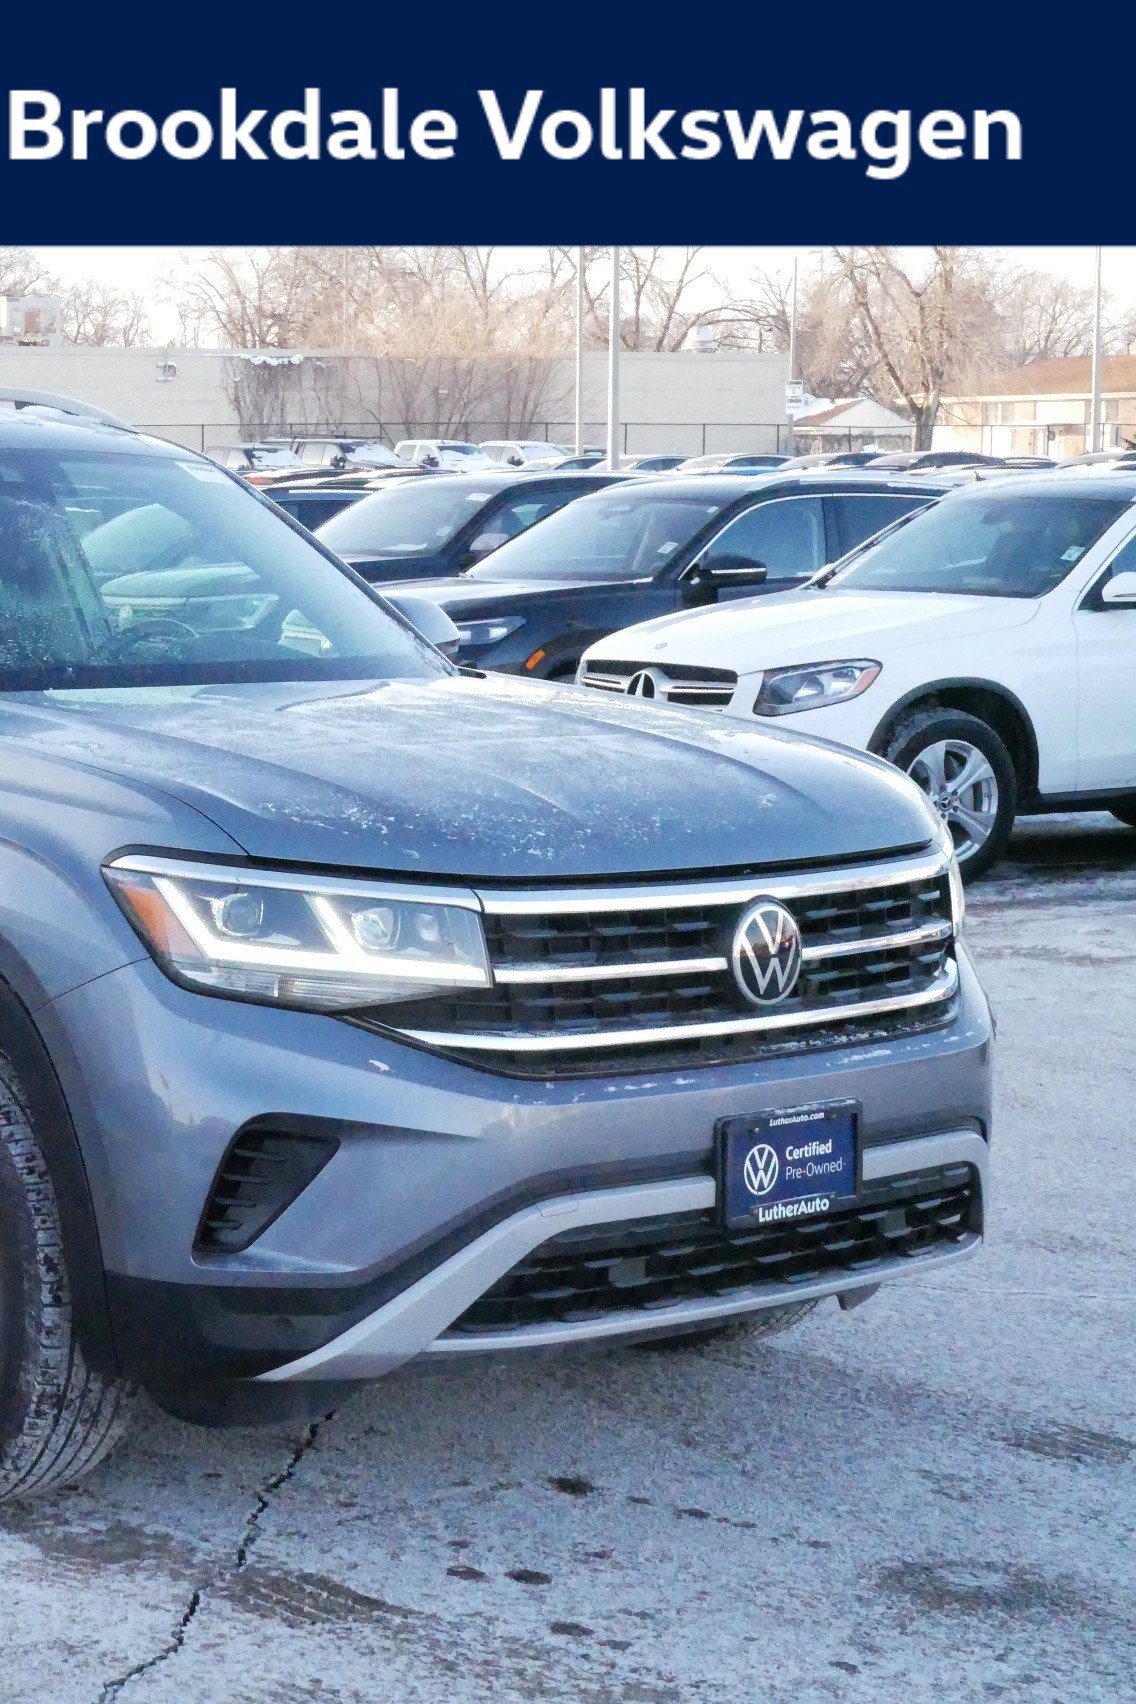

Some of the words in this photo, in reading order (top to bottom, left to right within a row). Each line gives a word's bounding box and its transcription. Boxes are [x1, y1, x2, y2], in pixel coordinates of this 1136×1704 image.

[733, 903, 801, 1005] VW
[769, 1111, 825, 1127] LutherAuto.com
[785, 1139, 833, 1161] Certified
[743, 1143, 779, 1196] VW
[785, 1157, 843, 1181] Pre-Owned
[758, 1197, 830, 1223] LutherAuto
